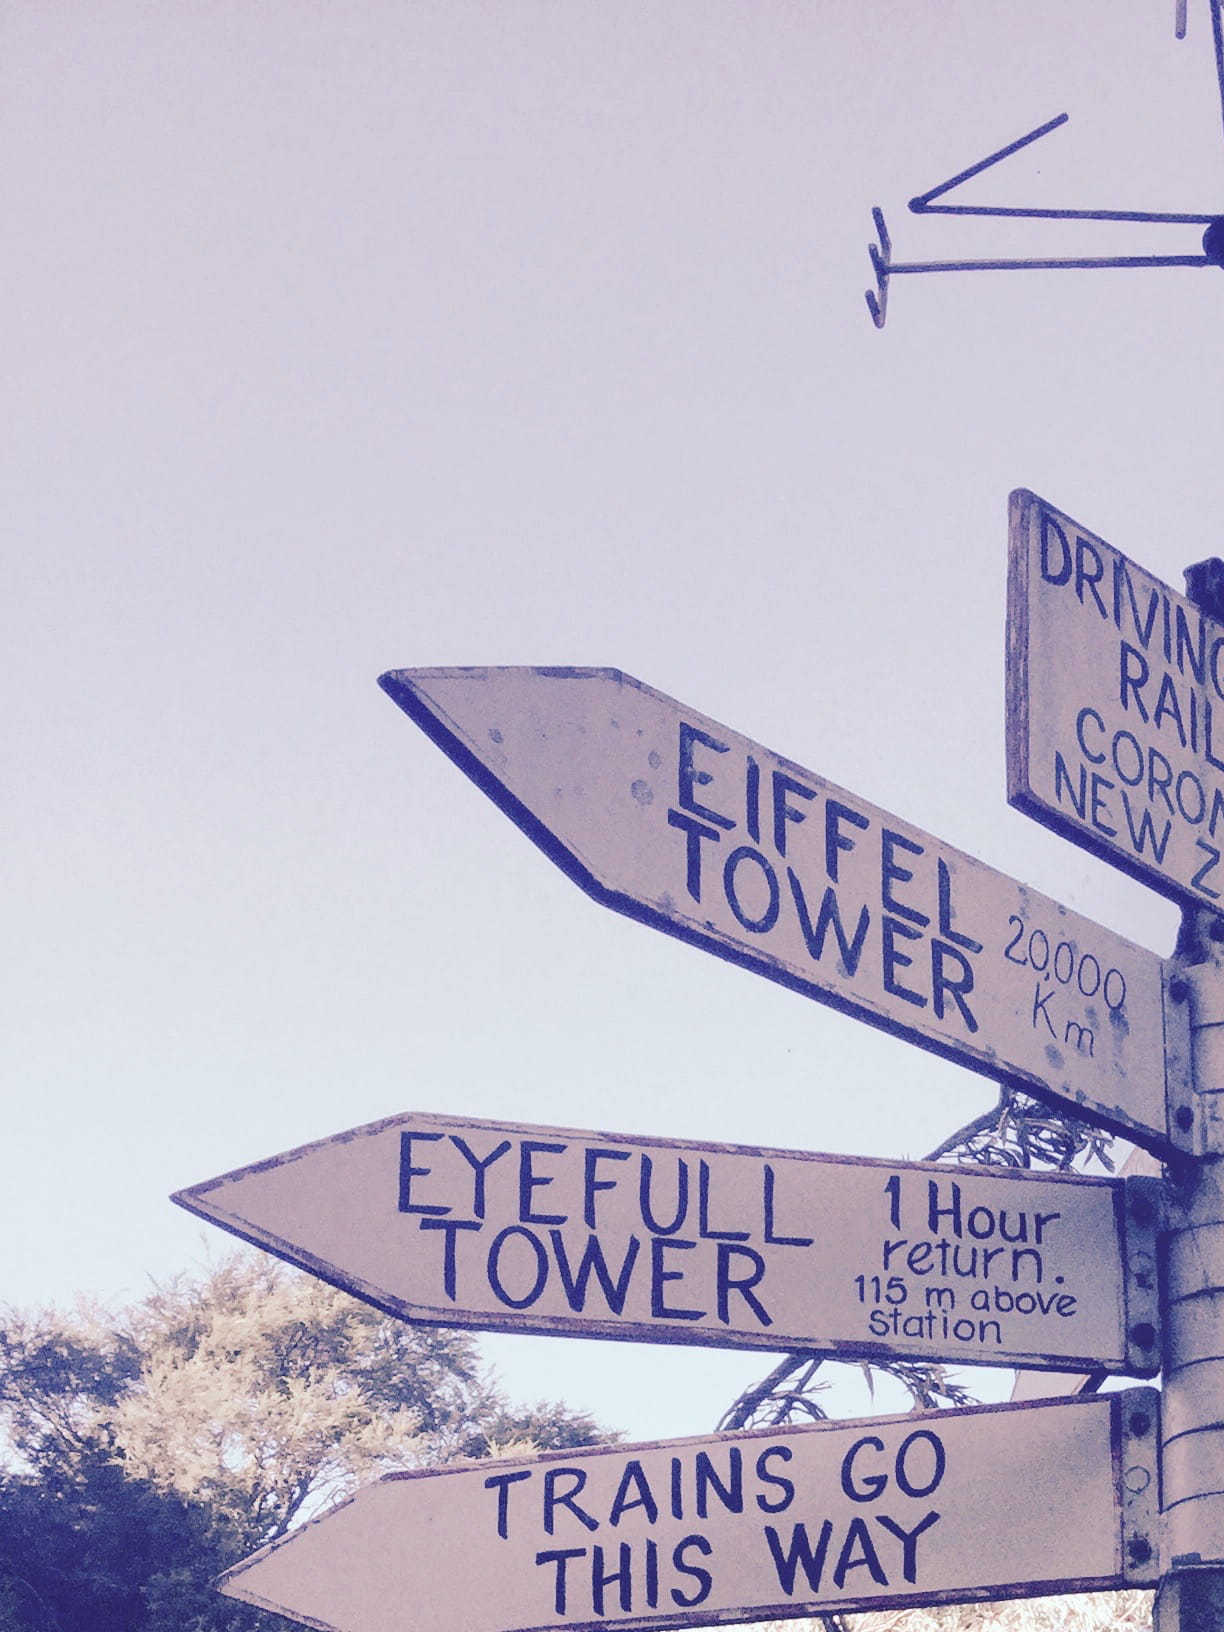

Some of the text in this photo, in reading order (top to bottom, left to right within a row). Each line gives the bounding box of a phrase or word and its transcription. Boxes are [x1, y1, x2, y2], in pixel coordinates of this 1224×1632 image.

[679, 721, 984, 953] EIFFEL
[1055, 751, 1172, 865] NEW
[668, 807, 979, 1033] TOWER
[1004, 914, 1127, 1011] 20,000
[399, 1131, 815, 1247] EYEFULL
[884, 1175, 1061, 1244] 1 Hour
[420, 1217, 773, 1327] TOWER
[855, 1274, 1078, 1317] 115 m above
[883, 1238, 1065, 1284] return.
[868, 1308, 1003, 1344] station
[484, 1430, 946, 1540] TRAINS GO
[535, 1510, 942, 1616] THIS WAY
